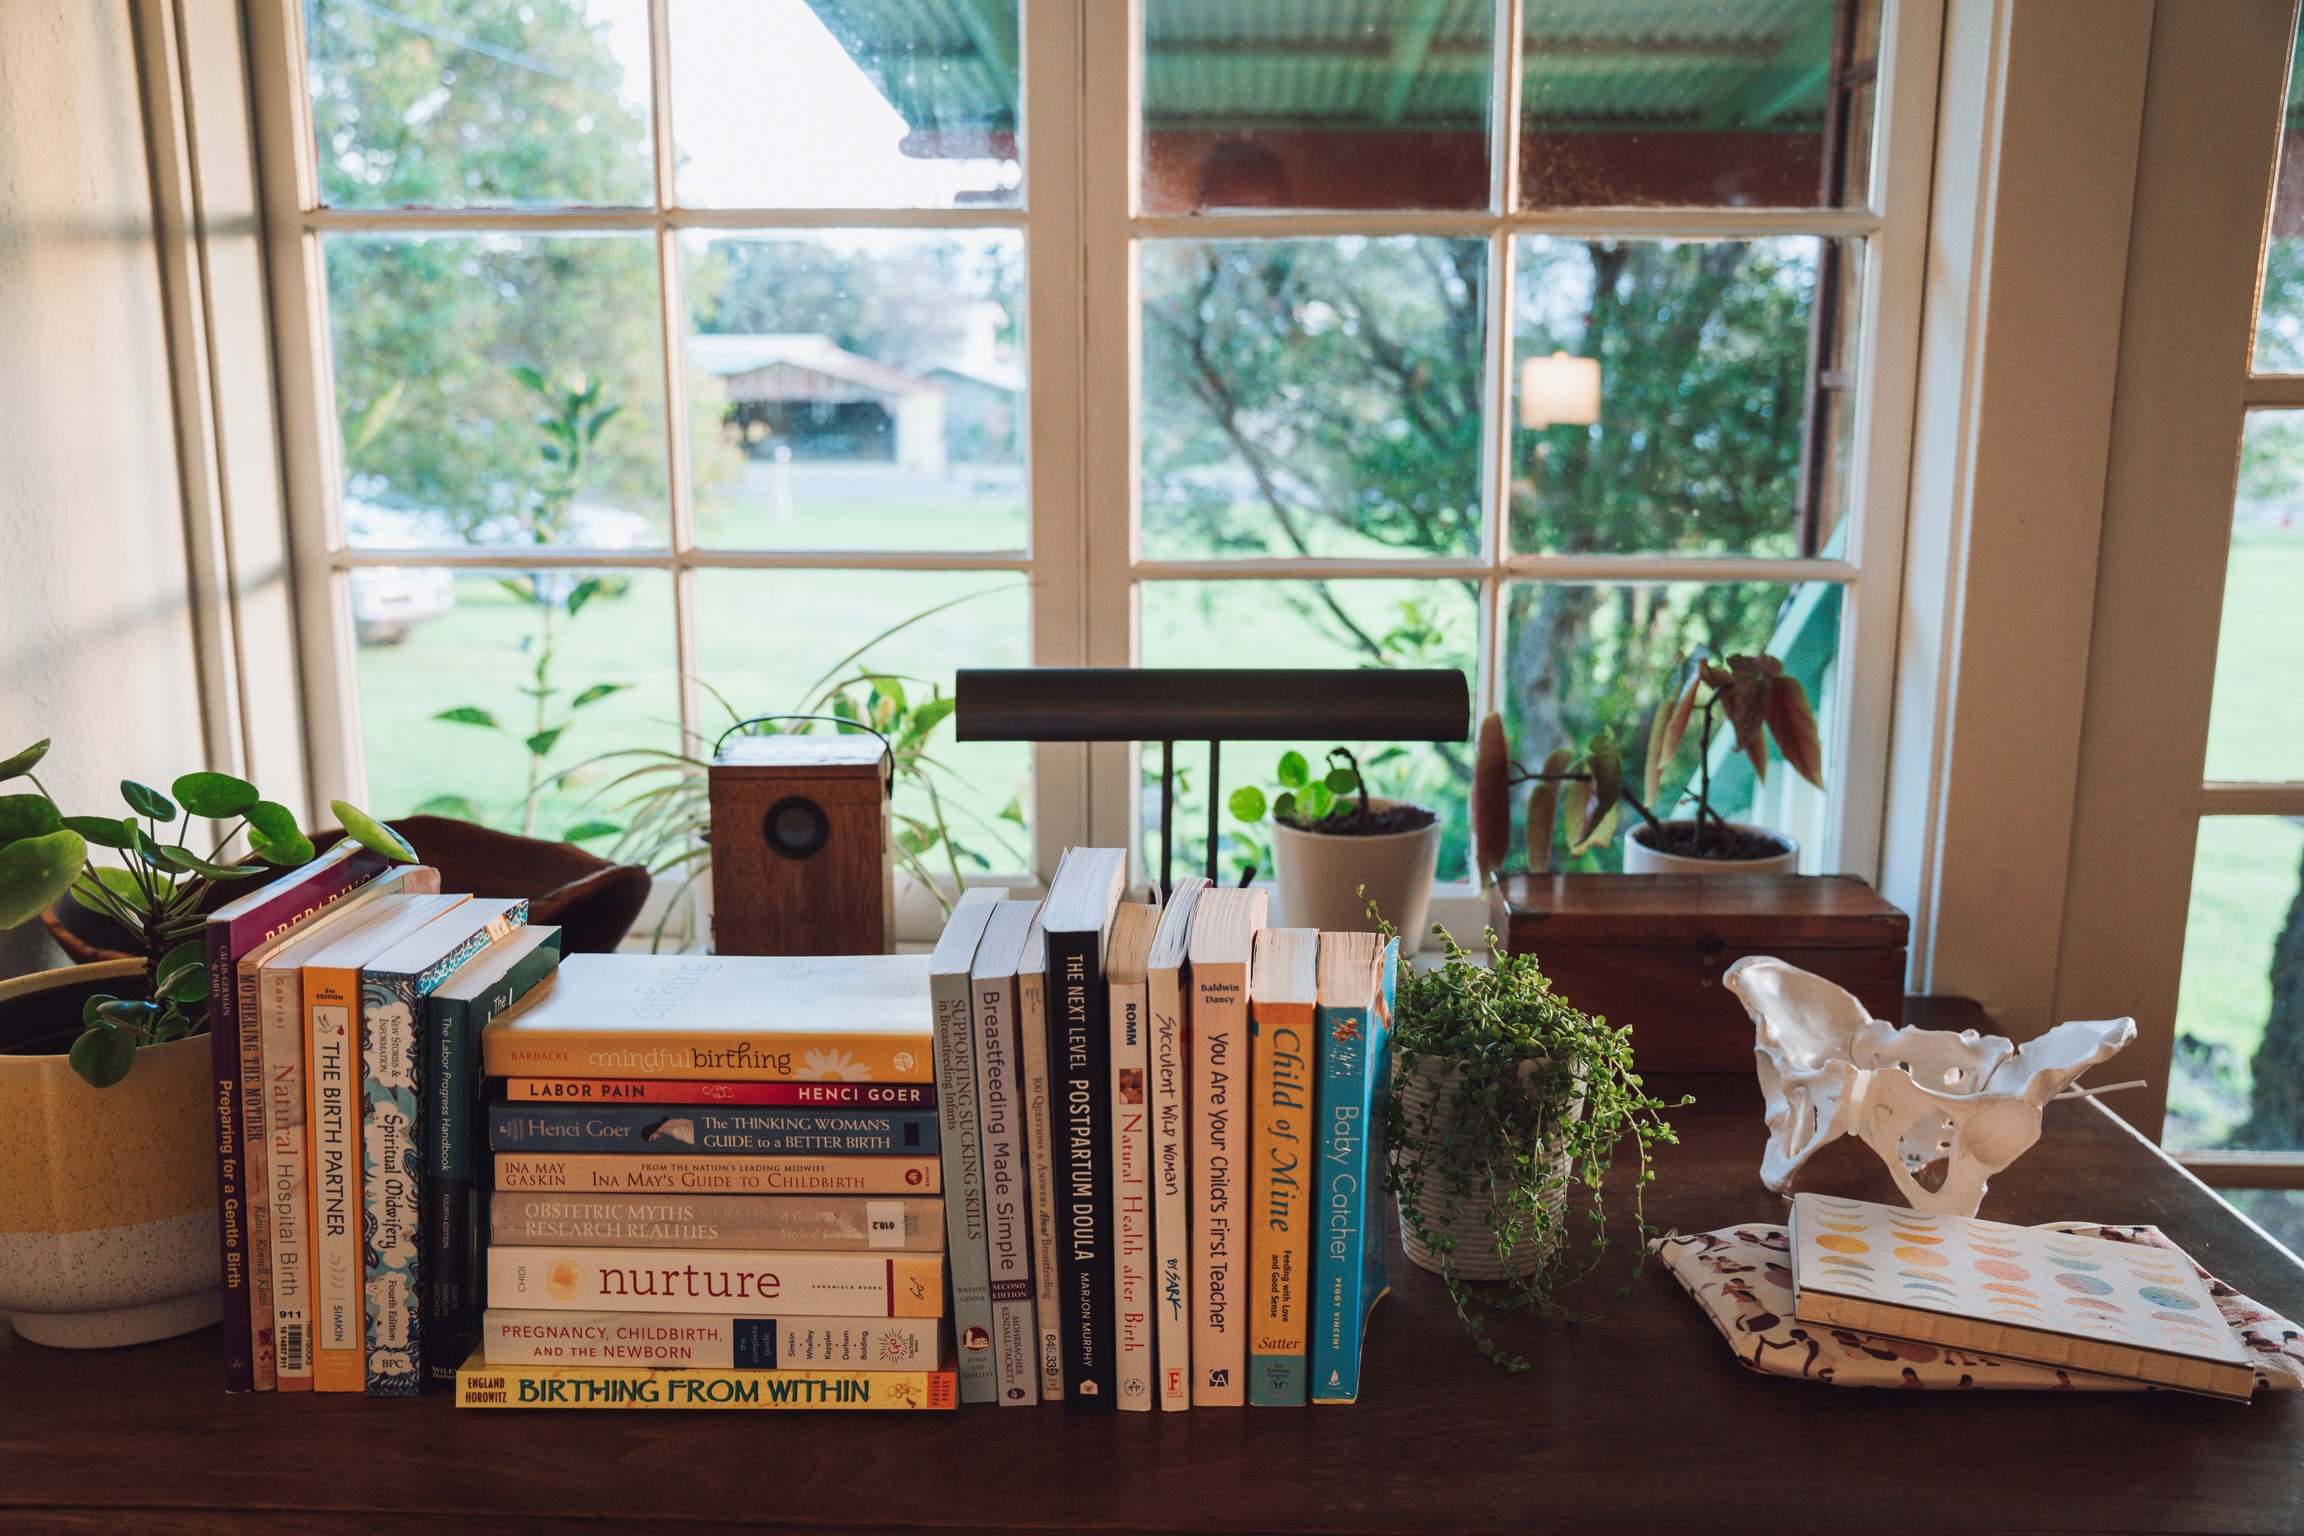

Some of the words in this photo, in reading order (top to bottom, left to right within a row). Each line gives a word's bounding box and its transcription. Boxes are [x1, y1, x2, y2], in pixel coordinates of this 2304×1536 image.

[220, 945, 231, 1017] CALAIS-GERMAIN
[1067, 954, 1084, 981] THE
[1200, 983, 1240, 992] Baldwin
[1205, 996, 1235, 1005] Dancy
[239, 973, 259, 1052] MOTHERING
[275, 978, 285, 1030] Gabriel
[939, 1000, 950, 1012] in
[1068, 986, 1085, 1023] NEXT
[390, 1015, 402, 1036] NEW
[441, 1016, 451, 1036] The
[1126, 1003, 1137, 1046] ROMM
[322, 1041, 341, 1082] THE
[379, 1018, 389, 1074] INFORMATION
[390, 1036, 402, 1068] STORIES
[442, 1040, 451, 1069] Labor
[511, 1052, 569, 1061] BARDACKE
[939, 1014, 954, 1089] Breastfeeding
[951, 999, 972, 1106] SUPPORTING
[1069, 1027, 1087, 1071] LEVEL
[1156, 1012, 1179, 1099] Succulent
[1208, 1032, 1229, 1065] You
[244, 1056, 262, 1083] THE
[391, 1069, 400, 1078] &
[983, 991, 1006, 1134] Breastfeeding
[1272, 1028, 1305, 1110] Child
[439, 1072, 451, 1116] Progress
[530, 1083, 593, 1097] LABOR
[602, 1084, 646, 1098] PAIN
[798, 1087, 859, 1101] HENCI
[868, 1088, 921, 1102] GOER
[1032, 1076, 1044, 1093] 100
[1210, 1070, 1229, 1105] Are
[218, 1080, 235, 1154] Preparing
[245, 1088, 263, 1143] MOTHER
[272, 1064, 299, 1155] Natural
[323, 1087, 342, 1144] BIRTH
[702, 1116, 728, 1130] The
[731, 1116, 811, 1131] THINKING
[814, 1118, 890, 1132] WOMAN'S
[945, 1092, 958, 1130] Infants
[1033, 1095, 1045, 1150] QUESTIONS
[377, 1114, 404, 1174] Spiritual
[528, 1119, 581, 1137] Henci
[585, 1120, 632, 1138] Goer
[703, 1134, 753, 1148] GUIDE
[757, 1137, 771, 1149] to
[774, 1139, 781, 1149] a
[785, 1136, 842, 1149] BETTER
[846, 1136, 891, 1150] BIRTH
[1069, 1079, 1092, 1197] POSTPARTUM
[1207, 1109, 1229, 1151] Your
[1267, 1119, 1299, 1144] of
[1326, 1106, 1360, 1165] Baby
[440, 1118, 451, 1172] Handbook
[959, 1110, 977, 1185] SUCKING
[1037, 1152, 1045, 1160] &
[1122, 1113, 1143, 1184] Natural
[223, 1158, 237, 1180] for
[505, 1162, 530, 1174] INA
[535, 1162, 566, 1175] MAY
[506, 1174, 566, 1186] GASKIN
[641, 1163, 666, 1172] FROM
[670, 1163, 688, 1172] THE
[692, 1164, 736, 1172] NATION'S
[739, 1164, 781, 1173] LEADING
[783, 1165, 826, 1173] MIDWIFE
[681, 1171, 732, 1188] GUIDE
[739, 1176, 760, 1188] TO
[767, 1172, 865, 1189] CHILDBIRTH
[993, 1142, 1013, 1196] Made
[224, 1184, 234, 1194] a
[324, 1149, 344, 1237] PARTNER
[1037, 1162, 1049, 1208] ANSWERS
[1210, 1156, 1231, 1213] Child's
[1270, 1147, 1300, 1233] Mine
[274, 1163, 298, 1244] Hospital
[378, 1179, 404, 1250] Midwifery
[525, 1202, 623, 1220] OBSTETRIC
[627, 1204, 694, 1222] MYTHS
[965, 1188, 981, 1240] SKILLS
[1330, 1174, 1357, 1262] Catcher
[224, 1199, 240, 1248] Gentle
[253, 1205, 267, 1235] Klaus,
[442, 1221, 450, 1249] EDITION
[525, 1221, 621, 1238] RESEARCH
[627, 1223, 719, 1240] REALITIES
[872, 1221, 895, 1231] 618.2
[1040, 1210, 1051, 1237] About
[1073, 1204, 1095, 1261] DOULA
[1123, 1196, 1143, 1256] Health
[996, 1202, 1017, 1270] Simple
[1210, 1218, 1230, 1258] First
[227, 1252, 241, 1289] Birth
[253, 1239, 268, 1276] Kennell,
[1041, 1238, 1053, 1300] Breastfeeding
[1166, 1258, 1178, 1270] BY
[1271, 1254, 1280, 1270] and
[1281, 1250, 1292, 1282] Feeding
[280, 1252, 300, 1297] Birth
[517, 1265, 526, 1293] CHIDI
[599, 1264, 781, 1299] nurture
[957, 1285, 987, 1293] WATSON
[1123, 1265, 1144, 1302] after
[1271, 1272, 1280, 1294] Good
[258, 1279, 269, 1308] Klaus
[388, 1280, 398, 1309] Fourth
[992, 1290, 1027, 1298] EDITION
[1080, 1272, 1091, 1319] MARJON
[1210, 1262, 1228, 1333] Teacher
[1270, 1295, 1279, 1318] Sense
[1282, 1284, 1292, 1302] with
[1334, 1277, 1342, 1307] PEGGY
[280, 1310, 302, 1319] 911
[333, 1305, 344, 1342] SIMKIN
[388, 1310, 398, 1341] Edition
[1281, 1304, 1291, 1323] Love
[502, 1325, 610, 1341] PREGNANCY,
[617, 1326, 723, 1343] CHILDBIRTH,
[764, 1332, 772, 1356] guide
[788, 1332, 796, 1357] Simkin
[806, 1329, 815, 1360] Whalley
[824, 1329, 832, 1360] Keppler
[842, 1330, 850, 1360] Durham
[860, 1330, 869, 1360] Bolding
[1001, 1306, 1014, 1385] KENDALL-TACKETT
[1012, 1315, 1024, 1375] MOHRBACHER
[1082, 1322, 1093, 1367] MURPHY
[1124, 1312, 1144, 1352] Birth
[1258, 1336, 1301, 1350] Satter
[1332, 1311, 1341, 1350] VINCENT
[281, 1356, 289, 1370] 911
[381, 1359, 404, 1369] BPC
[534, 1347, 564, 1356] AND
[571, 1347, 597, 1357] THE
[603, 1345, 692, 1359] NEWBORN
[465, 1391, 507, 1403] HOROWITZ
[467, 1377, 505, 1389] ENGLAND
[518, 1378, 659, 1403] BIRTHING
[667, 1379, 760, 1403] FROM
[767, 1379, 870, 1403] WITHIN
[931, 1375, 940, 1406] PARTERA
[941, 1379, 950, 1402] PRESS
